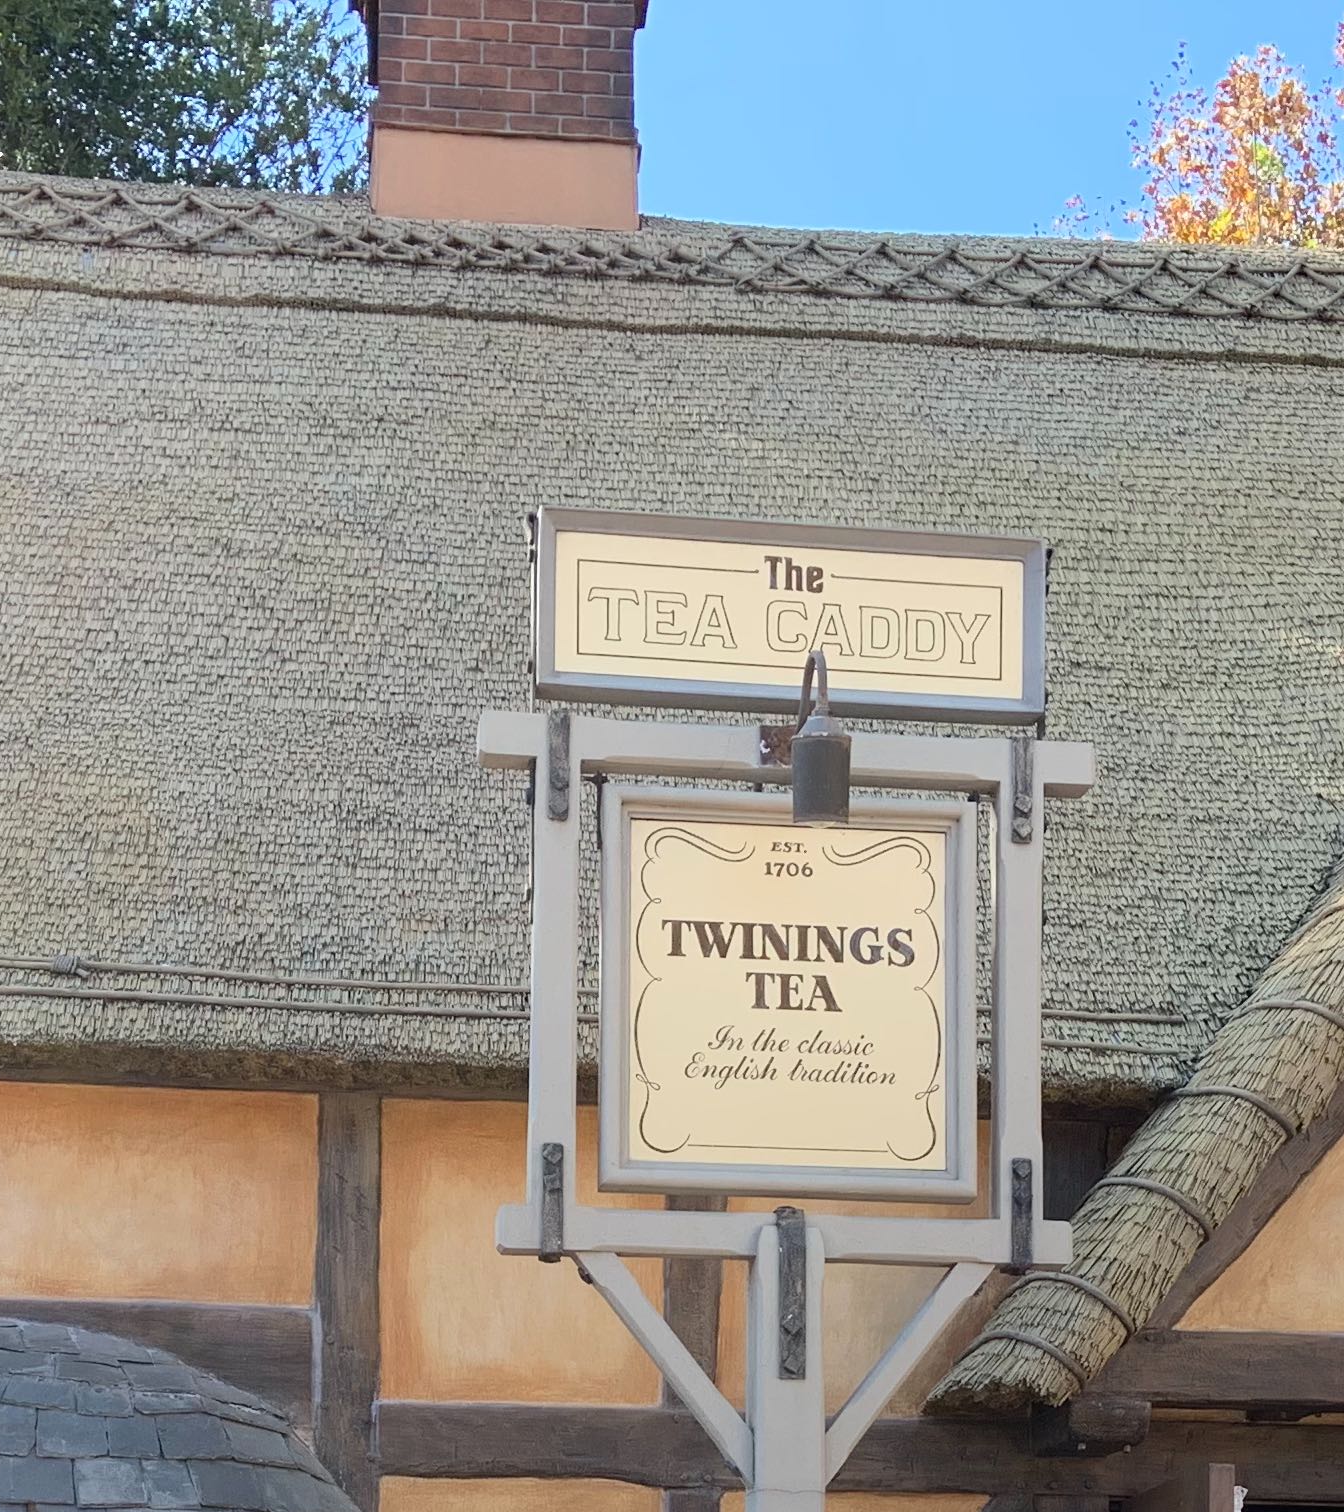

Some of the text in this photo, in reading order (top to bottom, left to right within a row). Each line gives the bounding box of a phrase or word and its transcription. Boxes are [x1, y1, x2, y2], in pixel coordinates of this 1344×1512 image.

[763, 555, 824, 594] The
[587, 586, 992, 665] TEA CADDY
[770, 841, 808, 854] EST.
[763, 861, 814, 878] 1706
[661, 919, 916, 968] TWININGS
[745, 971, 843, 1014] TEA
[707, 1024, 876, 1057] In the classic
[683, 1051, 897, 1090] English tradition
